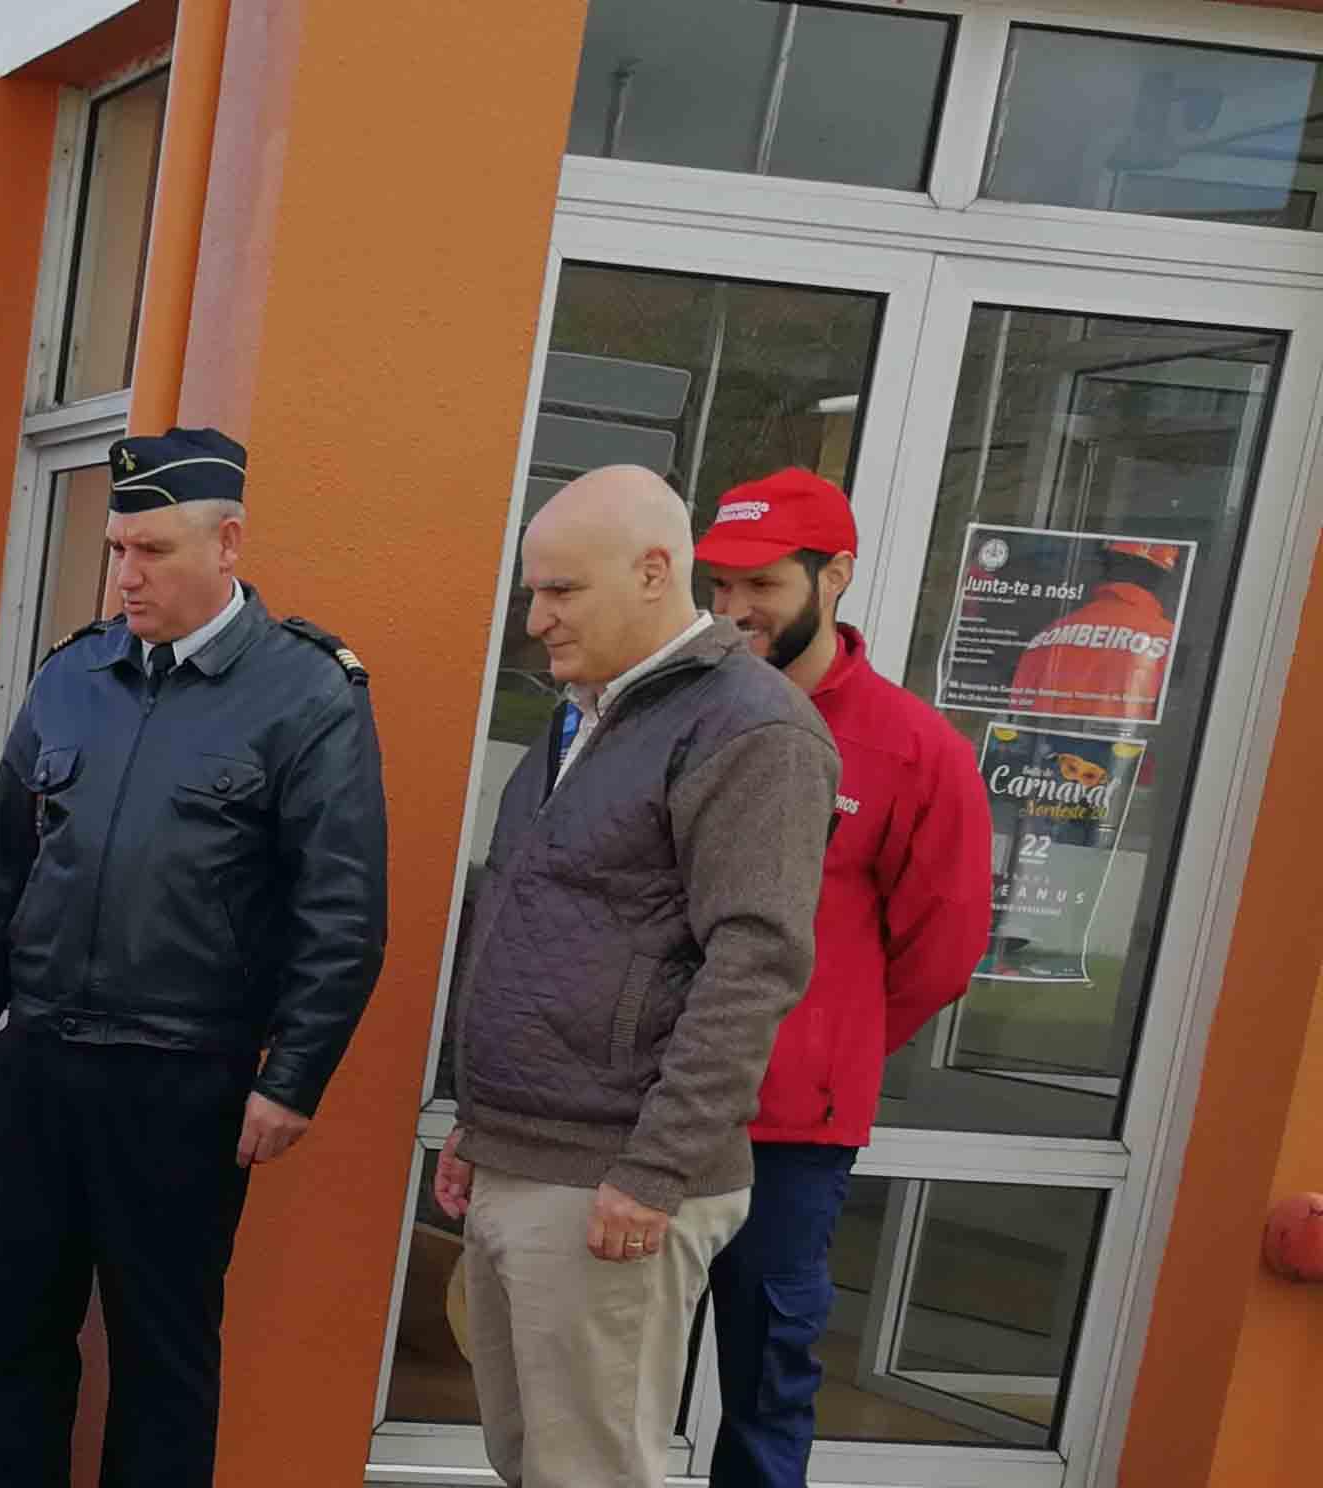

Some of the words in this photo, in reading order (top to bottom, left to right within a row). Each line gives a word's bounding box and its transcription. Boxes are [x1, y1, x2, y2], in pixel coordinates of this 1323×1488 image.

[963, 575, 1029, 596] Junta-te
[1031, 586, 1042, 597] a
[1045, 580, 1084, 600] nós!
[989, 764, 1118, 811] Carnaval
[1020, 832, 1052, 858] 22
